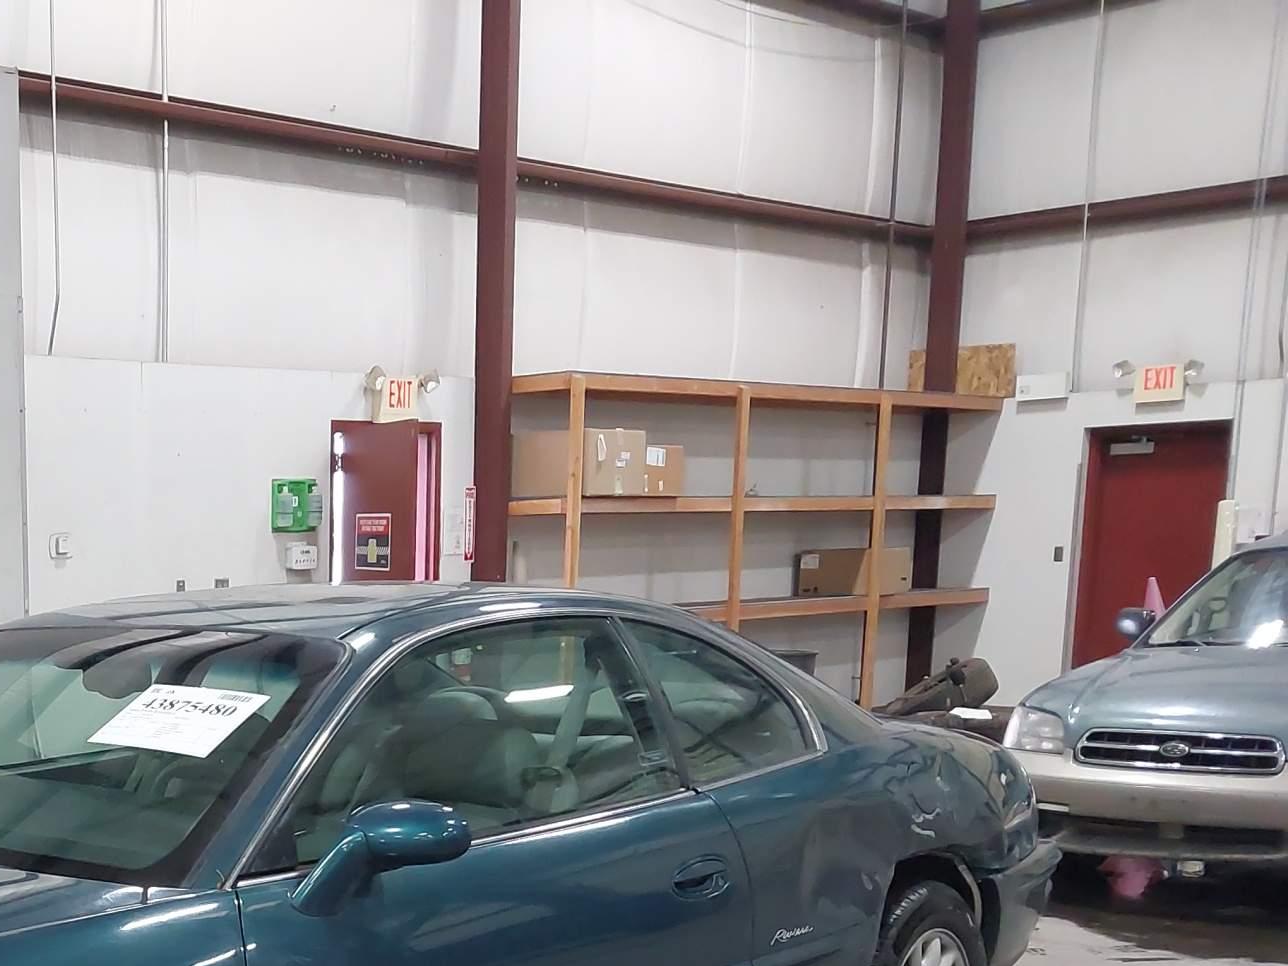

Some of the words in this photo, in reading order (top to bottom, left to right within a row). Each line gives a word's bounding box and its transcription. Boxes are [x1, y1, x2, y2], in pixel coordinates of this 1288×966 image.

[1143, 366, 1177, 391] EXIT
[388, 379, 413, 409] EXIT
[142, 697, 238, 718] 43875480
